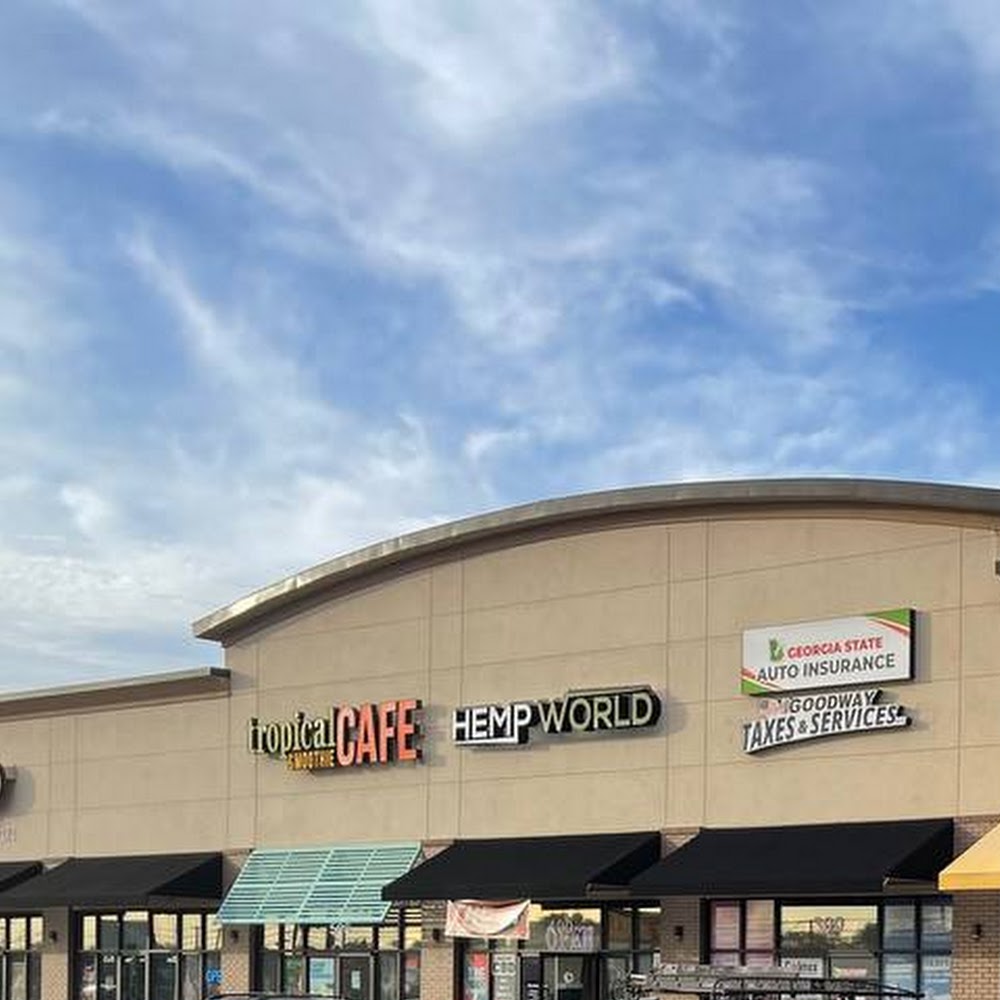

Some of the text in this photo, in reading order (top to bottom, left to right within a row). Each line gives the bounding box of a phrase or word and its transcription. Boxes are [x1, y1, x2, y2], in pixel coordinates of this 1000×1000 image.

[787, 636, 883, 660] GEORGIA STATE
[757, 653, 896, 682] AUTO INSURANCE
[452, 692, 652, 744] HEMP WORLD
[788, 690, 875, 714] GOODWAY
[249, 699, 418, 766] tropical CAFE
[743, 706, 898, 750] TAXES & SERVICES
